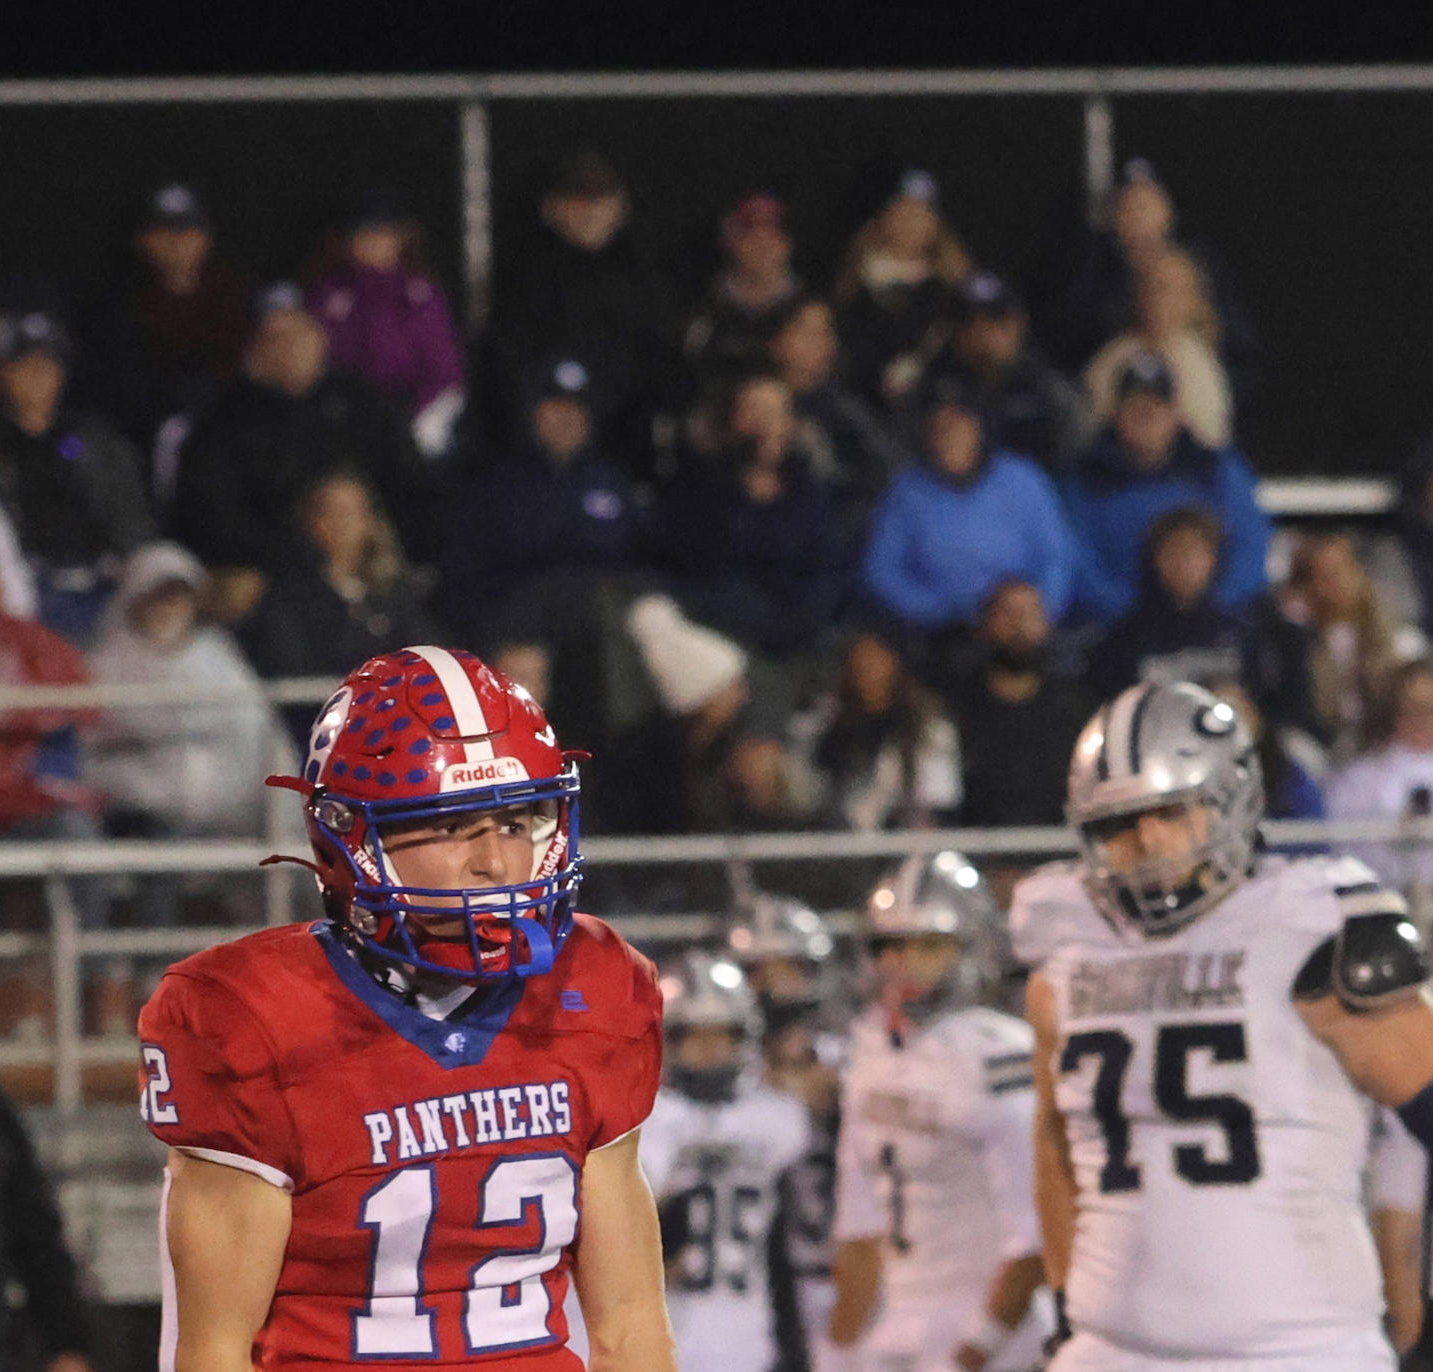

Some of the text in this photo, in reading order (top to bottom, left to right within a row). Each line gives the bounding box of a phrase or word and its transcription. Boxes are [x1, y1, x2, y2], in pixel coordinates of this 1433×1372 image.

[363, 1080, 572, 1166] PANTHERS
[1061, 1023, 1261, 1192] 75
[350, 1151, 581, 1360] 12
